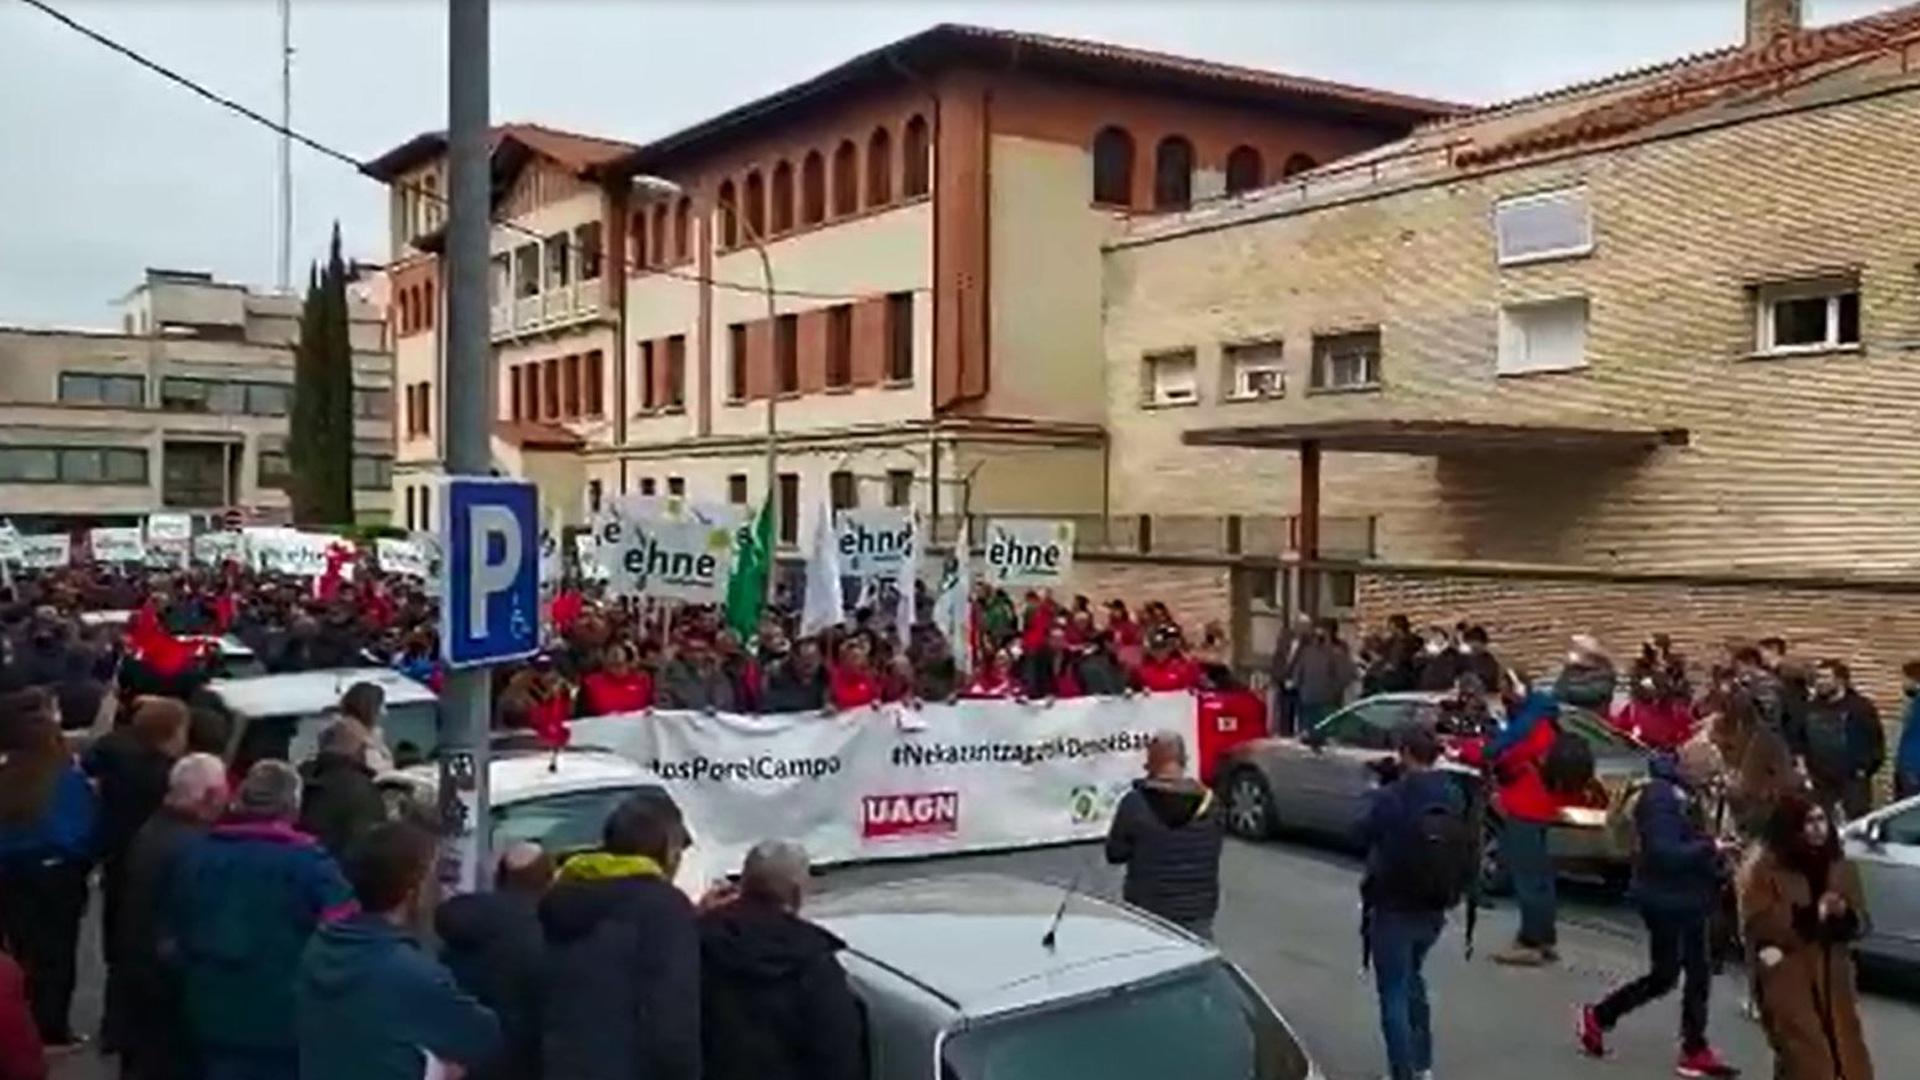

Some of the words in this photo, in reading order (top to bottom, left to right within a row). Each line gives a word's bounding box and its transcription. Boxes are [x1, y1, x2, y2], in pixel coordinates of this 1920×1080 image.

[624, 538, 716, 577] ehne
[989, 537, 1061, 565] ehne
[468, 504, 522, 640] P
[869, 799, 956, 824] UAGN
